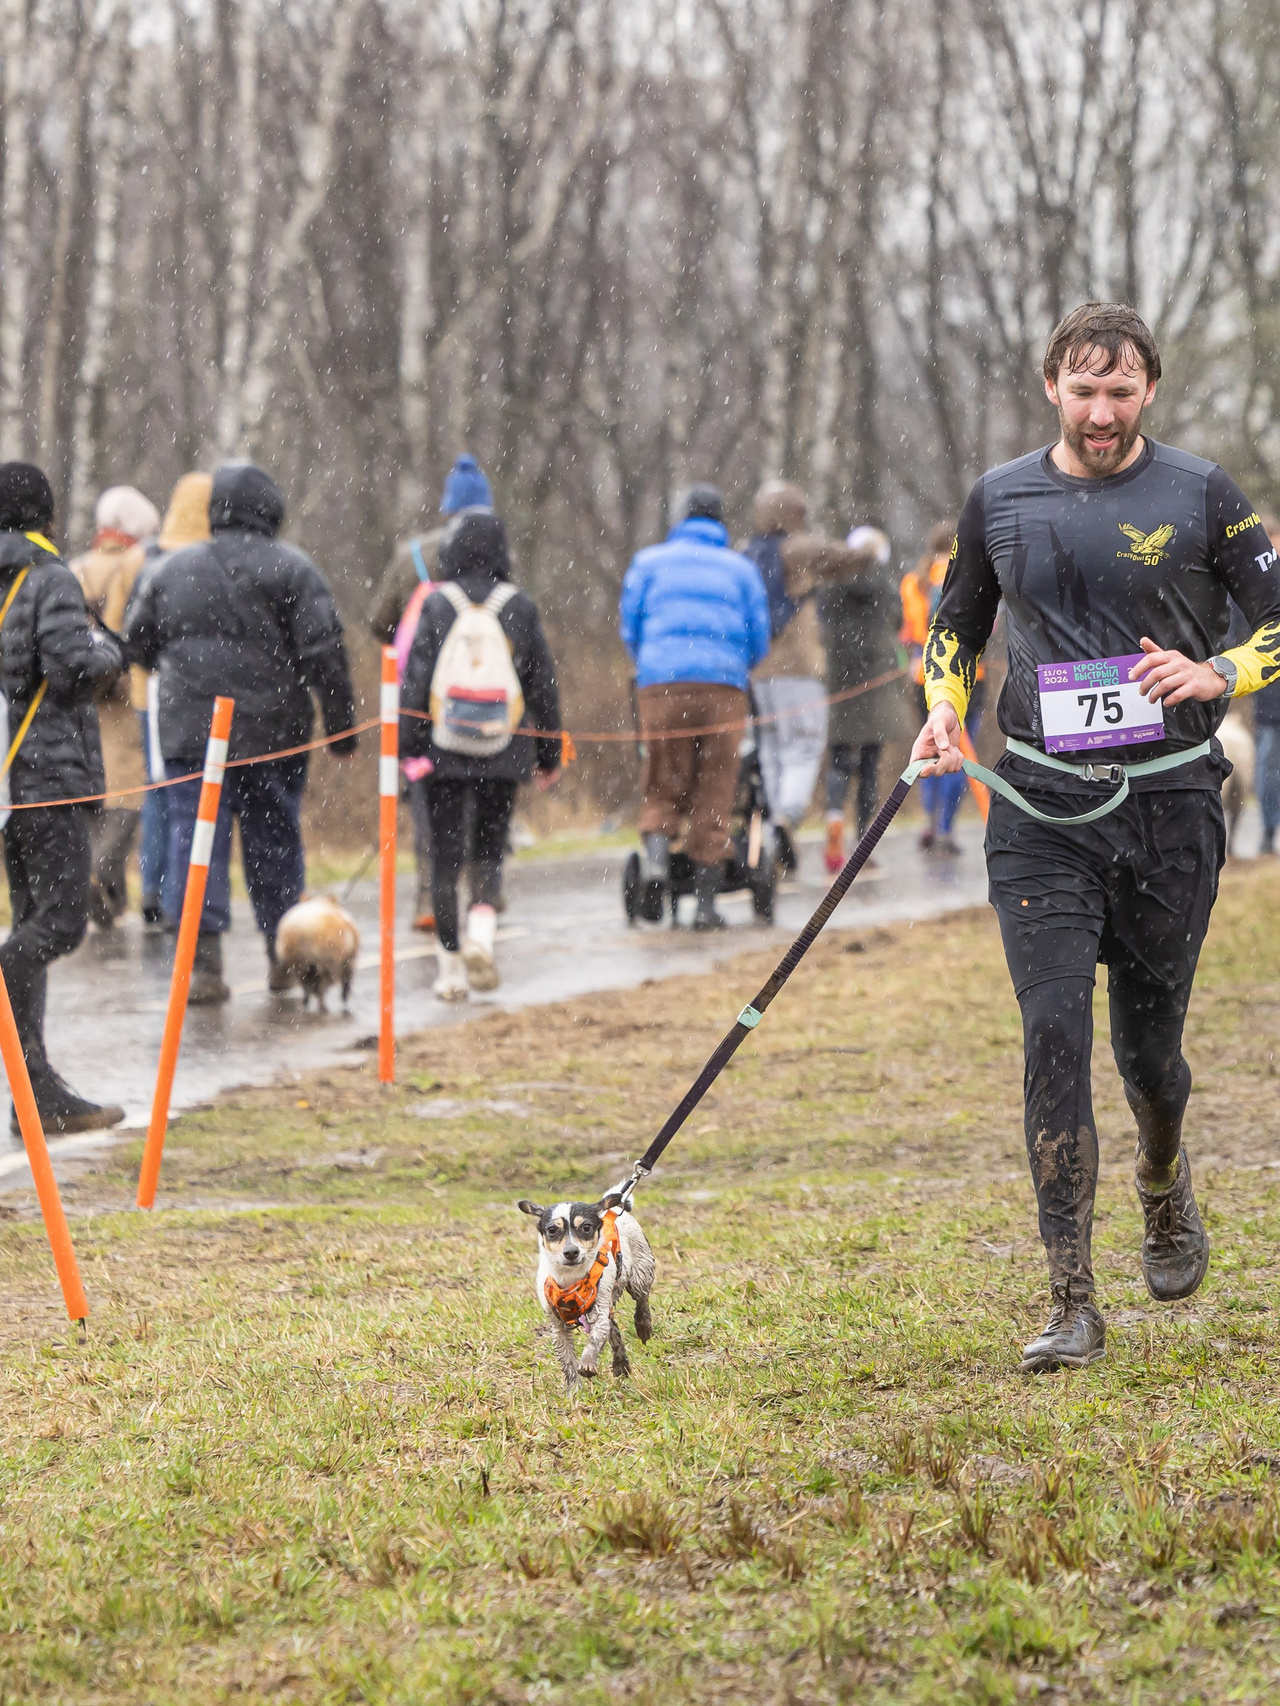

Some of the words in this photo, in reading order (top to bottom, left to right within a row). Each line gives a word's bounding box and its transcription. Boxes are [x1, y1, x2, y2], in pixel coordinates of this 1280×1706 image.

[1073, 661, 1108, 673] КРОСС
[1074, 666, 1119, 682] БЫСТРЫЙ
[1044, 676, 1069, 685] 2026
[1077, 690, 1124, 728] 75
